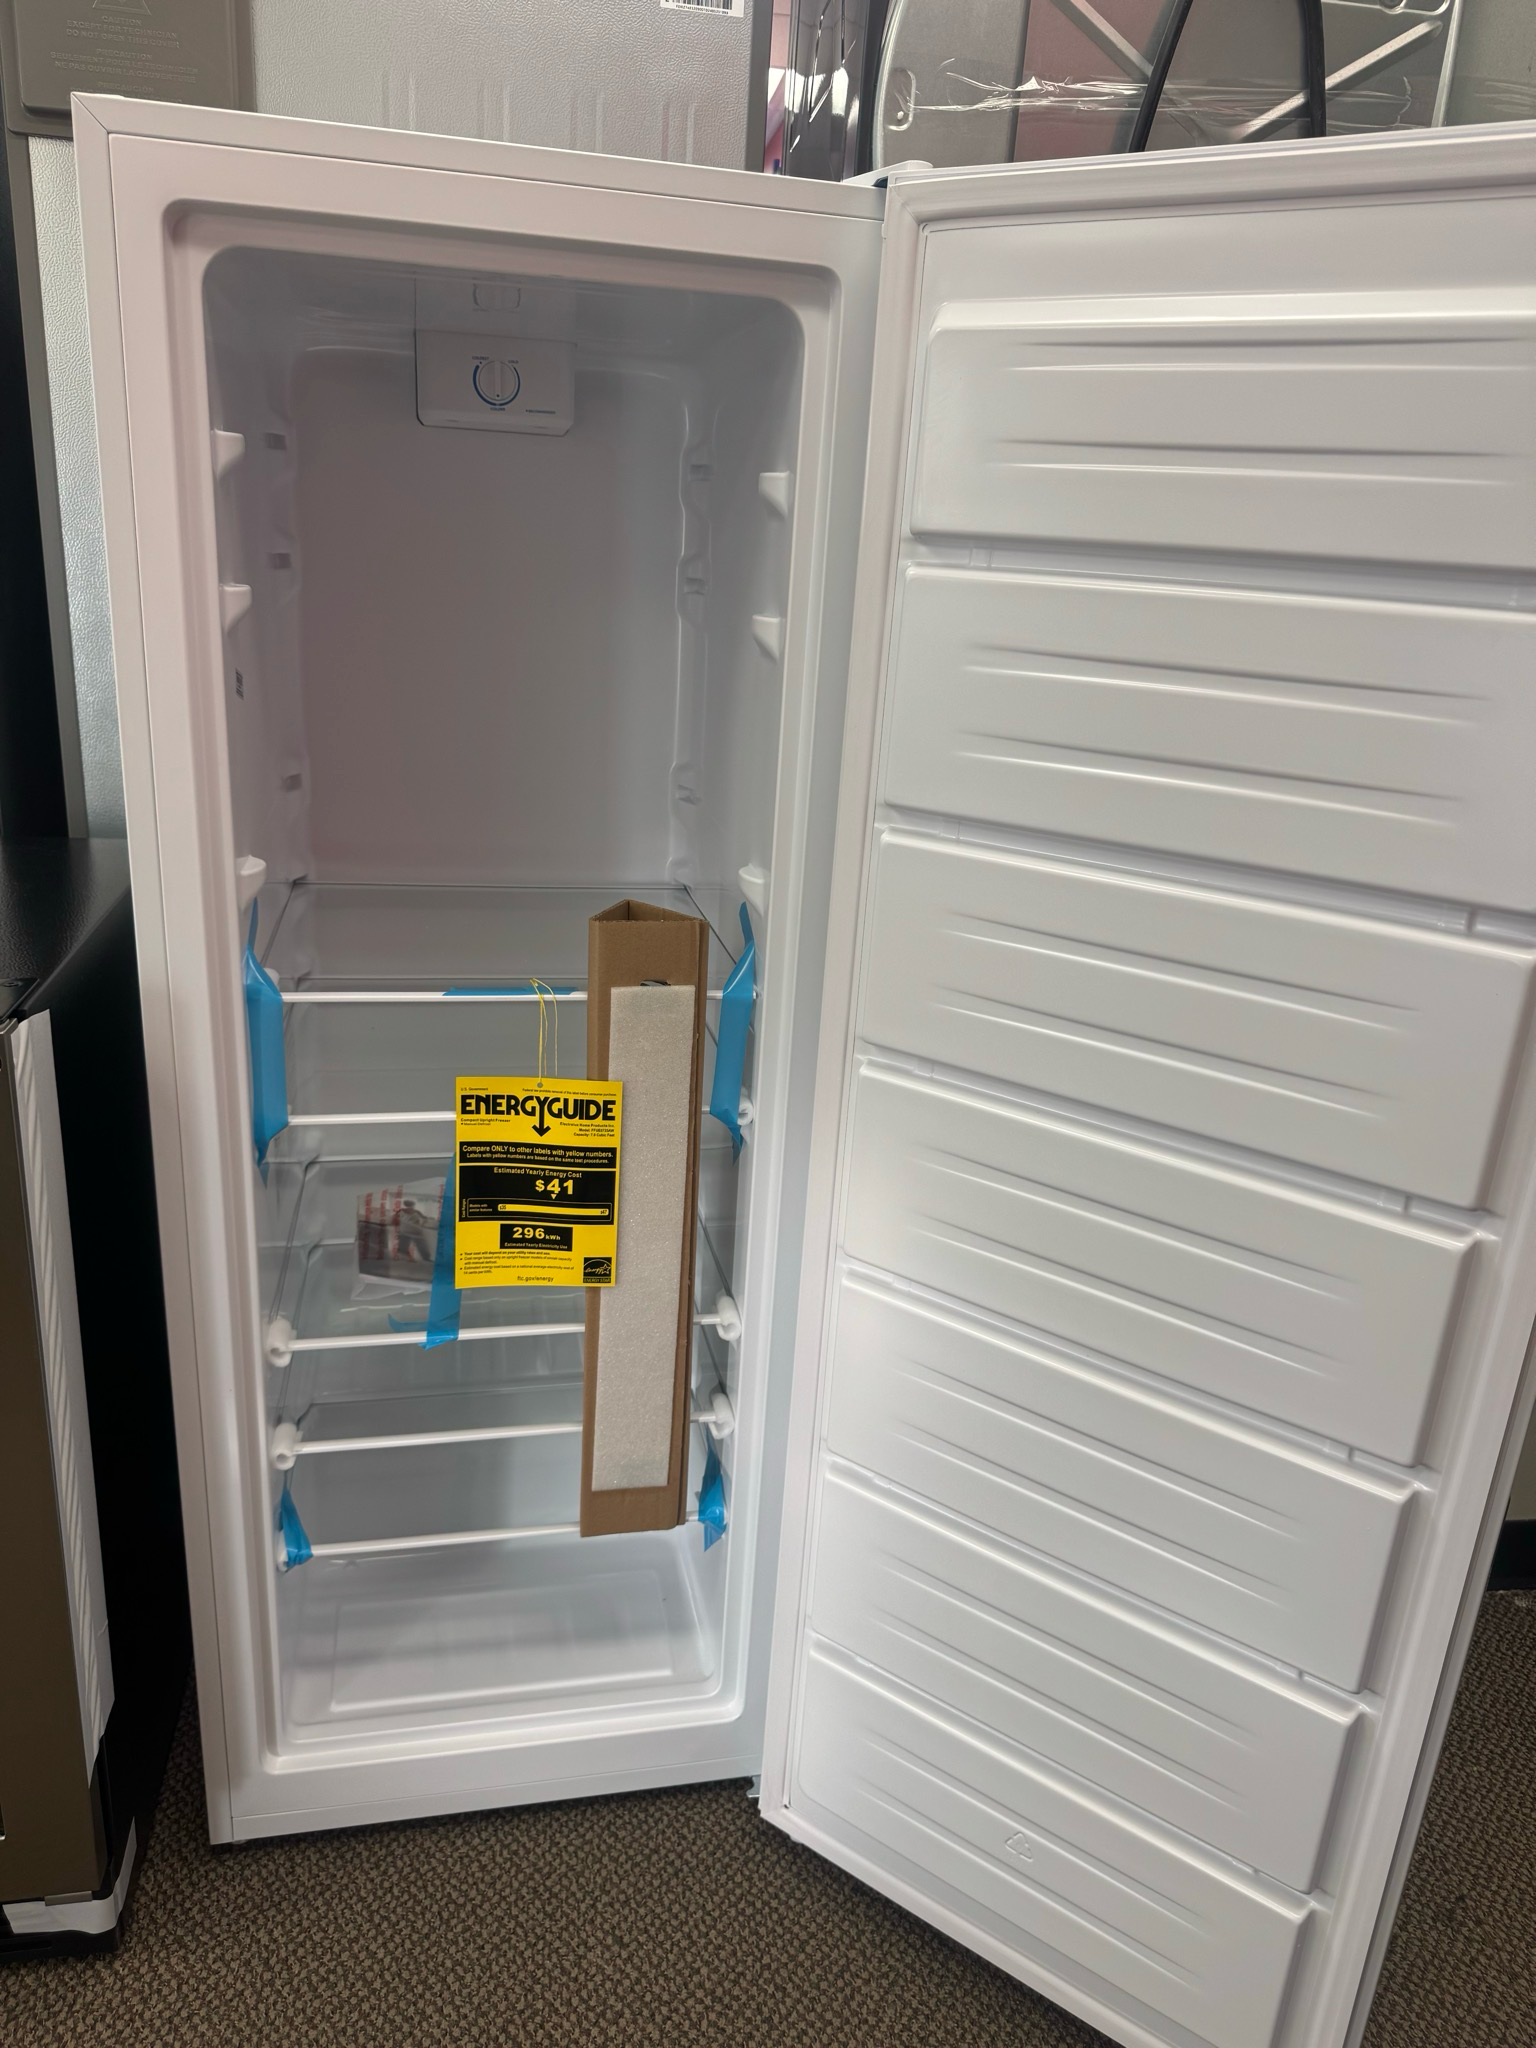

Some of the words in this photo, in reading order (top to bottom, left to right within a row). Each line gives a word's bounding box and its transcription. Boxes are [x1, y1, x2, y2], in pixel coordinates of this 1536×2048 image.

[102, 15, 142, 26] CAUTION
[67, 20, 101, 30] EXCEPT
[104, 25, 121, 33] FOR
[122, 27, 177, 39] TECHNICIAN
[66, 29, 79, 37] DO
[81, 31, 99, 39] NOT
[102, 34, 125, 42] OPEN
[127, 36, 148, 45] THIS
[96, 48, 153, 60] PRECAUTION
[69, 63, 86, 71] PAS
[461, 1094, 616, 1121] ENERGYGUIDE
[546, 1170, 566, 1178] Energy
[535, 1178, 573, 1194] $41
[513, 1227, 545, 1239] 296
